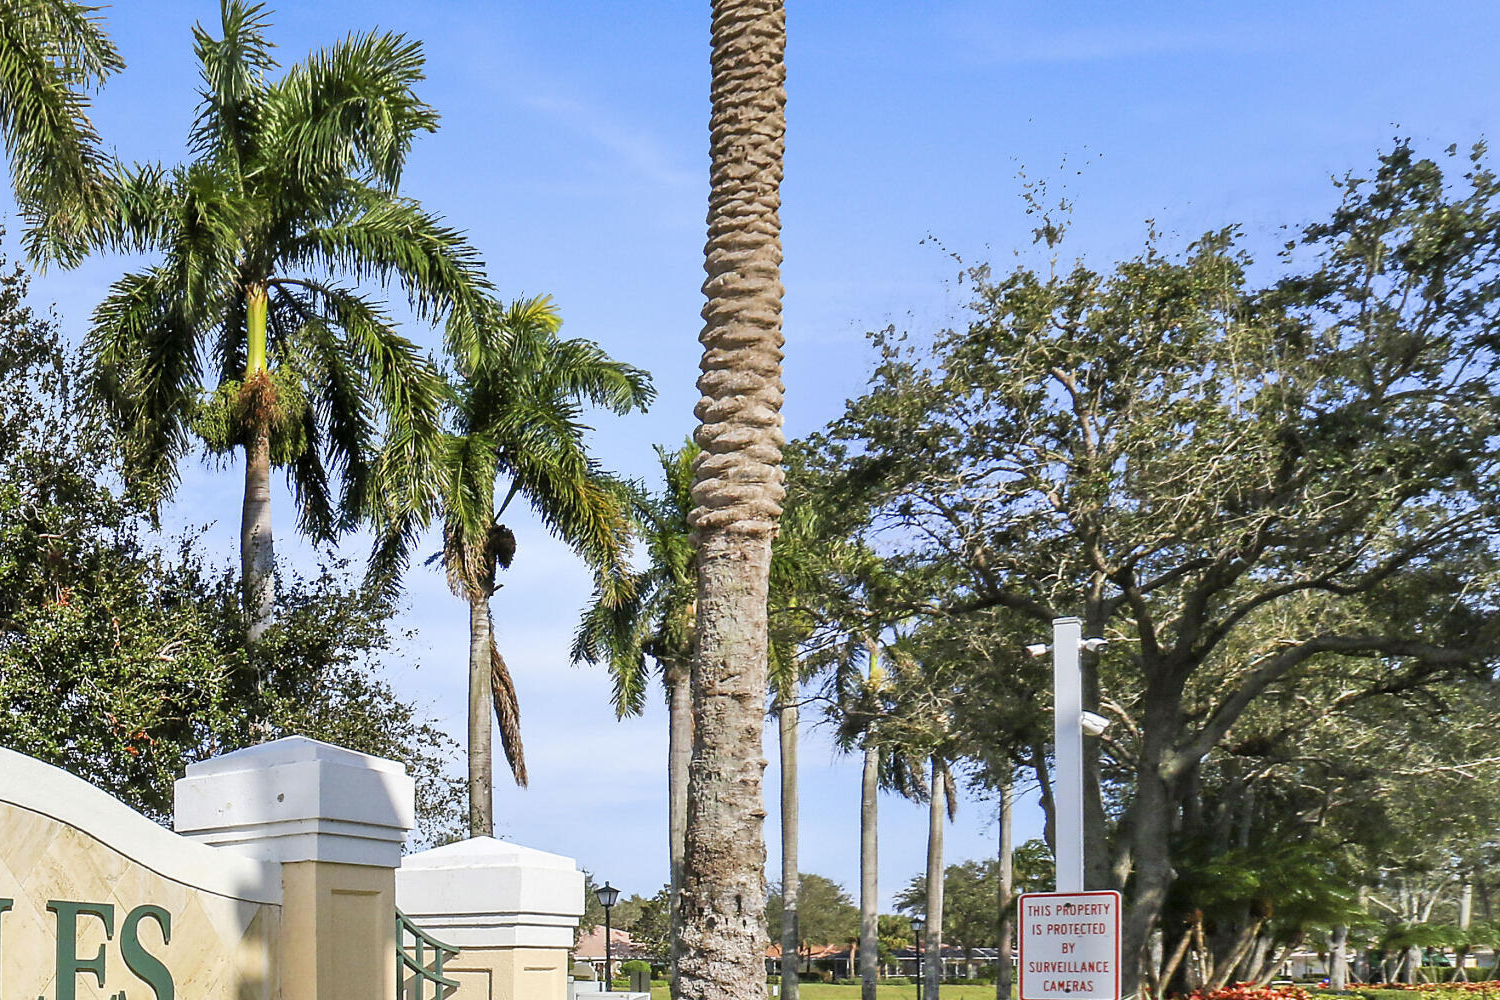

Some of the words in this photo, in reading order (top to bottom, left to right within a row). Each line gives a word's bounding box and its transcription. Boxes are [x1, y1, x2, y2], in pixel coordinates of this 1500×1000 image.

[1028, 905, 1051, 917] THIS
[1056, 903, 1110, 915] PROPERTY
[1032, 924, 1042, 936] IS
[1047, 923, 1106, 935] PROTECTED
[1062, 943, 1076, 954] BY
[1029, 961, 1109, 973] SURVEILLANCE
[1043, 980, 1094, 992] CAMERAS
